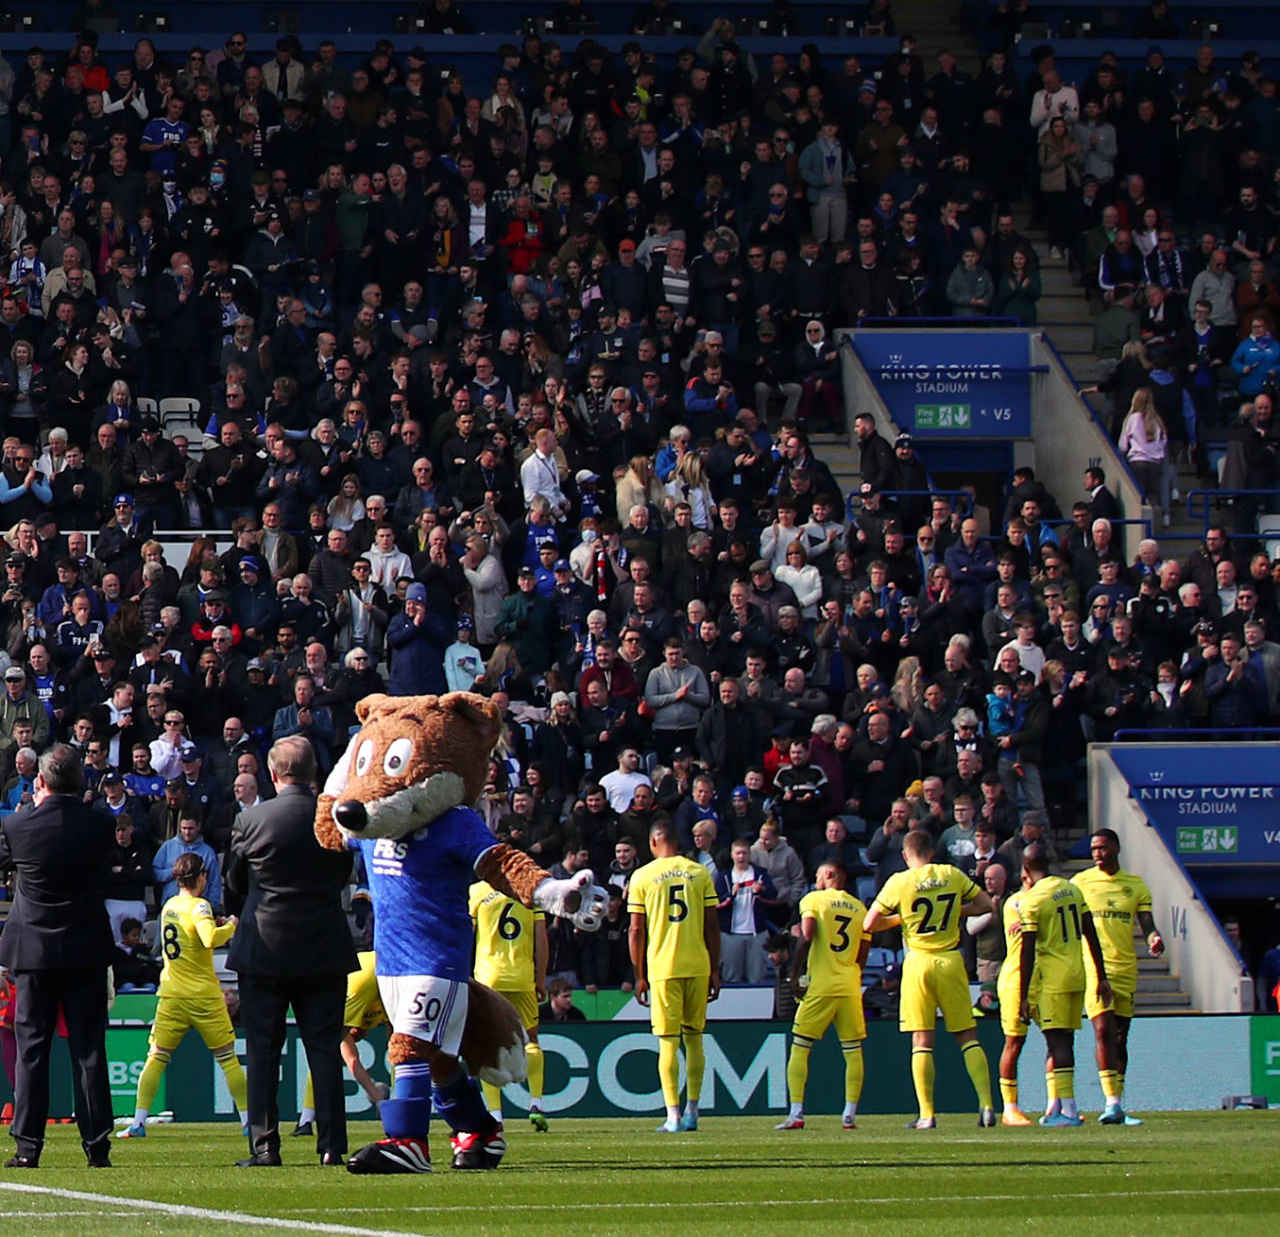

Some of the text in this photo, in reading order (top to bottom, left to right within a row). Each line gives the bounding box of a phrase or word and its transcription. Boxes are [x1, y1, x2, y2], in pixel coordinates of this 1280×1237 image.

[880, 364, 929, 380] KING
[915, 382, 969, 393] STADIUM
[993, 408, 1011, 420] V5
[1141, 787, 1274, 800] KING POWER
[1178, 802, 1237, 814] STADIUM
[373, 838, 408, 860] FBS
[1179, 831, 1197, 840] Fire
[668, 884, 688, 922] 5
[911, 892, 957, 934] 27
[497, 902, 522, 941] 6
[830, 914, 852, 953] 3
[1056, 903, 1082, 943] 11
[1171, 906, 1187, 941] V4
[161, 922, 181, 961] 8
[409, 992, 441, 1022] 50
